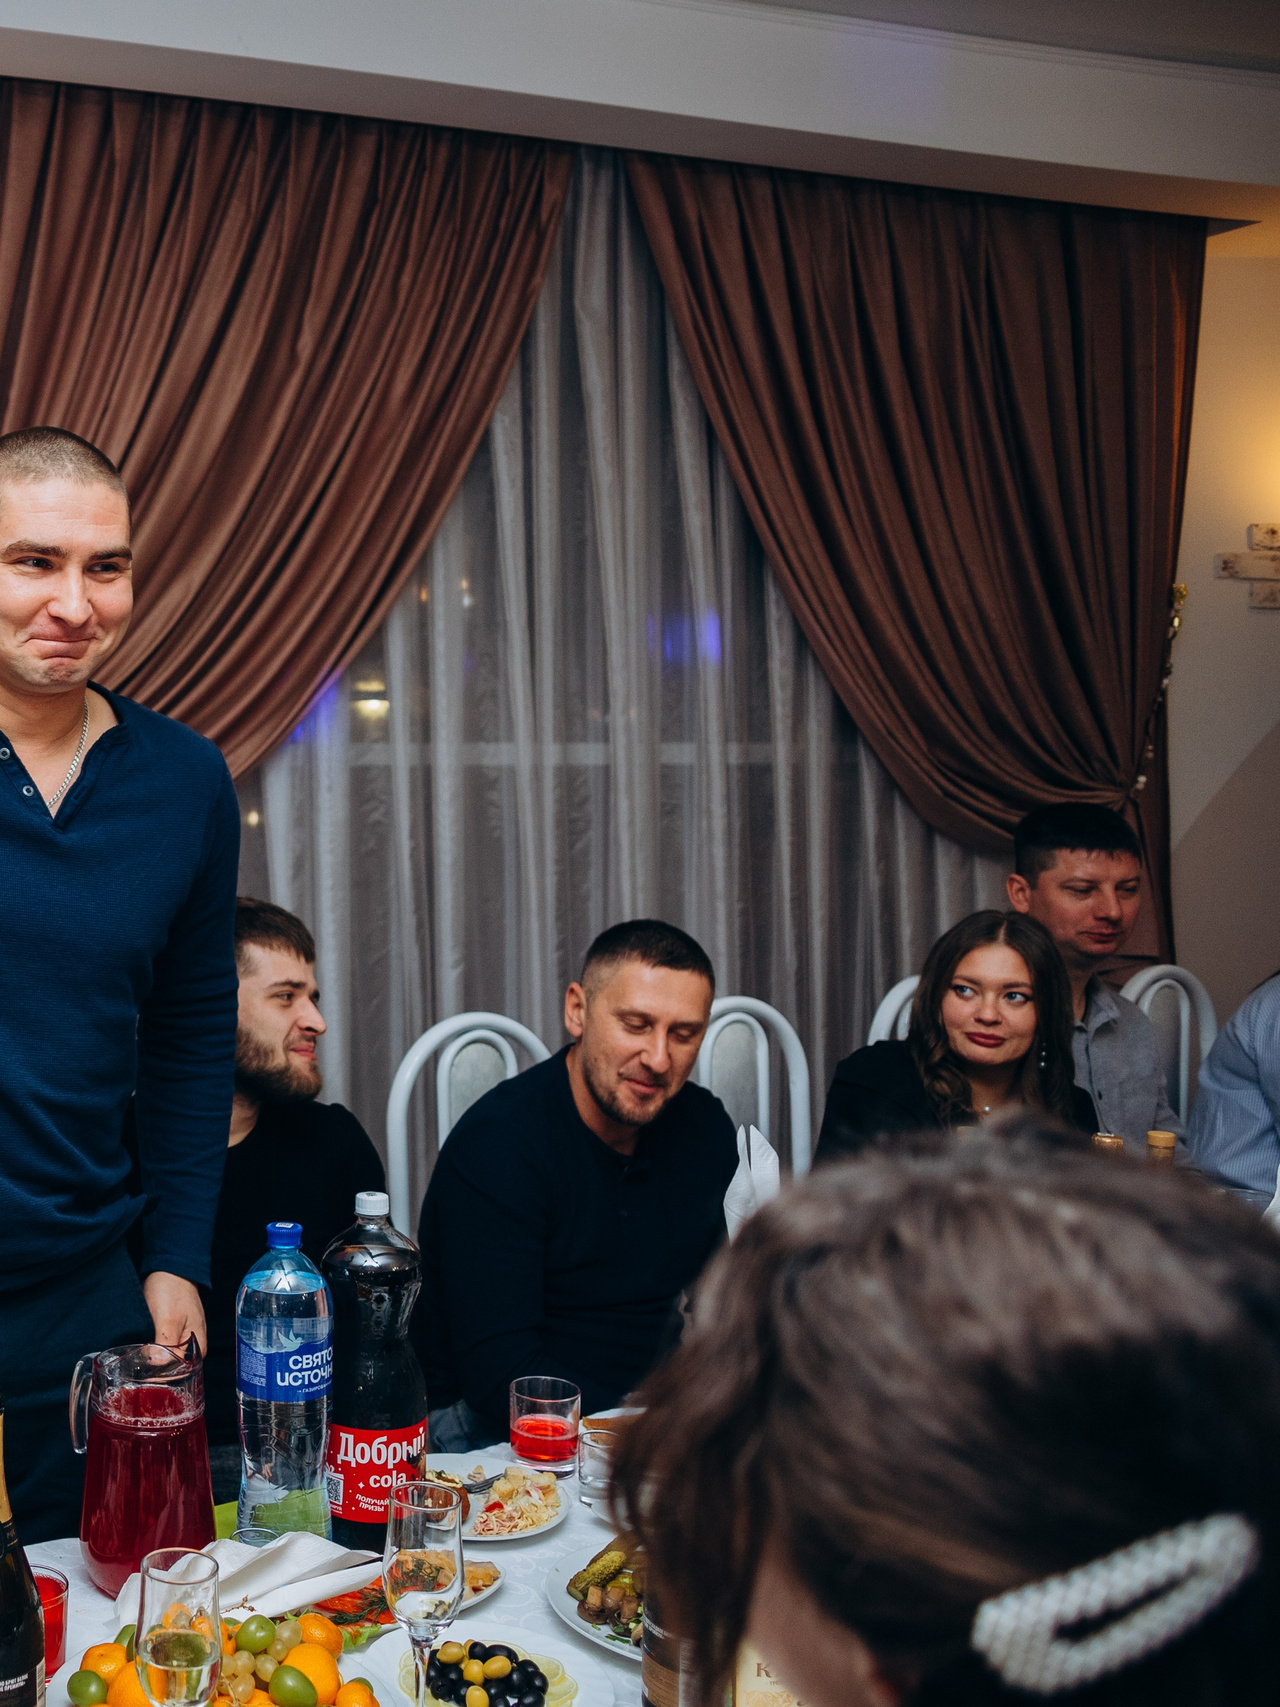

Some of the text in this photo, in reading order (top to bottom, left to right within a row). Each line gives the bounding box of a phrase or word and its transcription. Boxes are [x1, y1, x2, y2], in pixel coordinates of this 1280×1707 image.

[337, 1426, 425, 1469] Добрый
[369, 1470, 406, 1488] cola
[355, 1493, 390, 1506] ПОЛУЧАЙ
[359, 1502, 385, 1512] ПРИЗЫ
